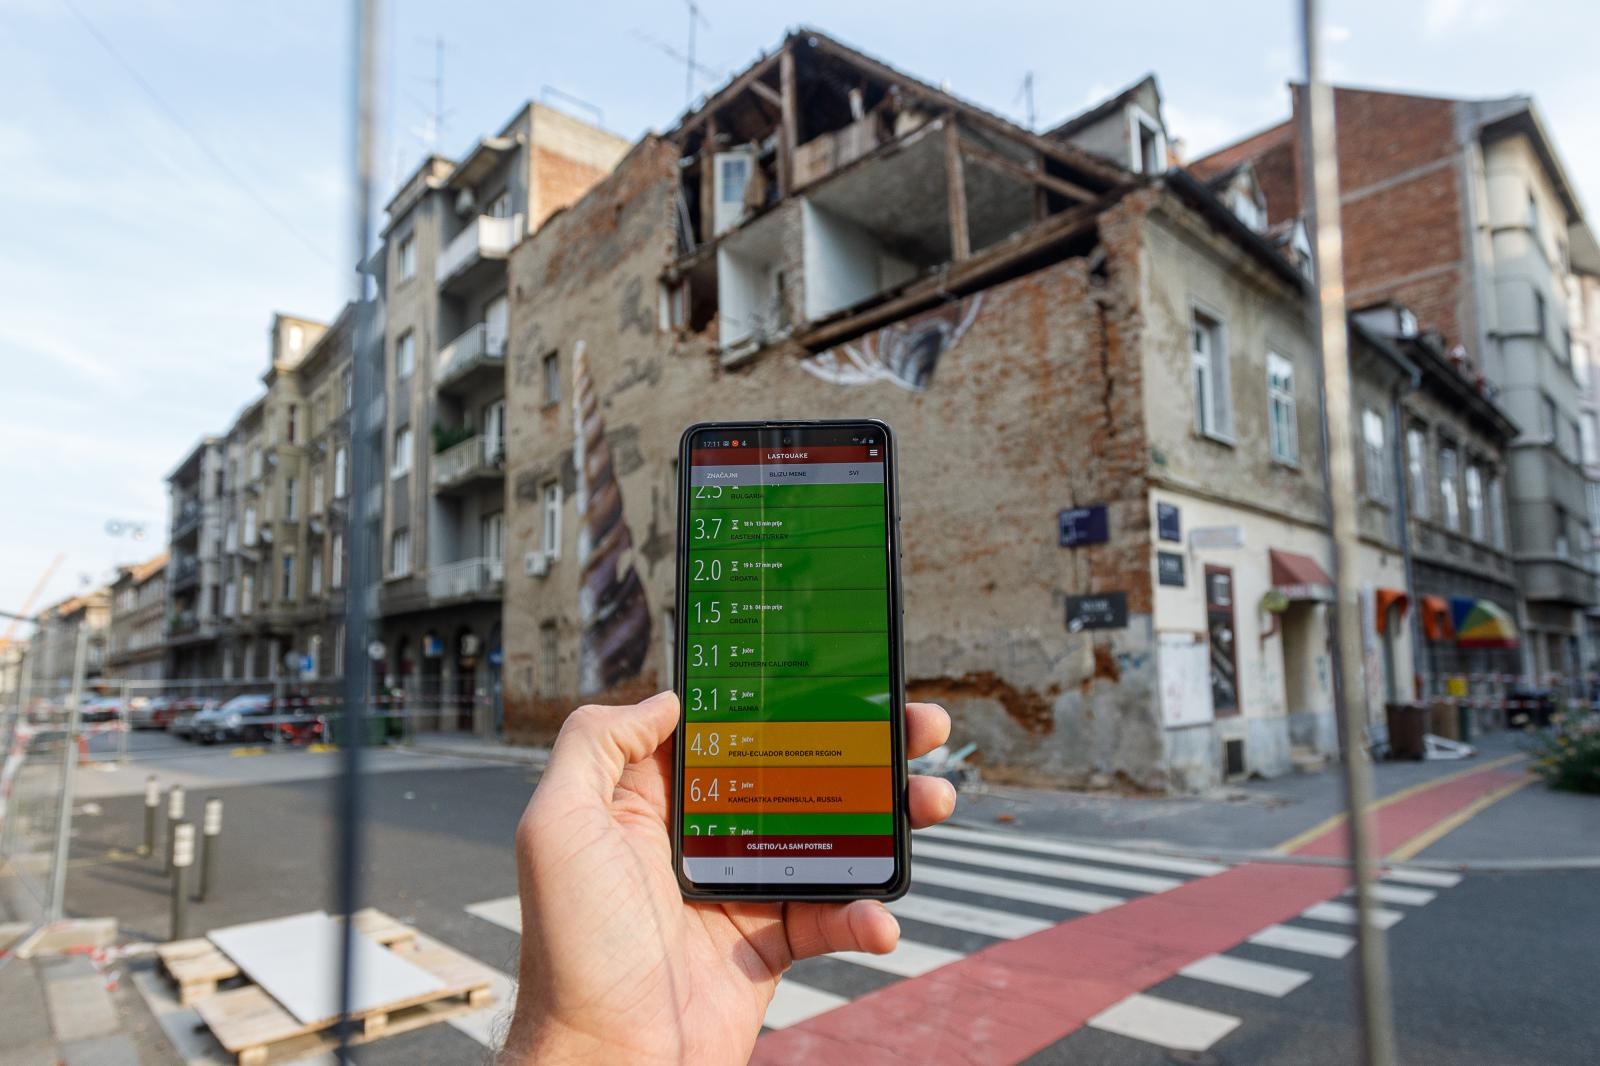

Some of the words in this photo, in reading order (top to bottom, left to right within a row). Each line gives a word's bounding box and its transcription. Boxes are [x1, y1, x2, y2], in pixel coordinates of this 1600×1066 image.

[694, 518, 722, 540] 3.7
[694, 559, 721, 581] 2.0
[694, 601, 721, 624] 1.5
[692, 644, 718, 667] 3.1
[768, 660, 810, 668] CALIFORNIA
[692, 688, 718, 711] 3.1
[690, 732, 719, 755] 4.8
[690, 778, 719, 801] 6.4
[728, 796, 771, 804] KAMCHATKA
